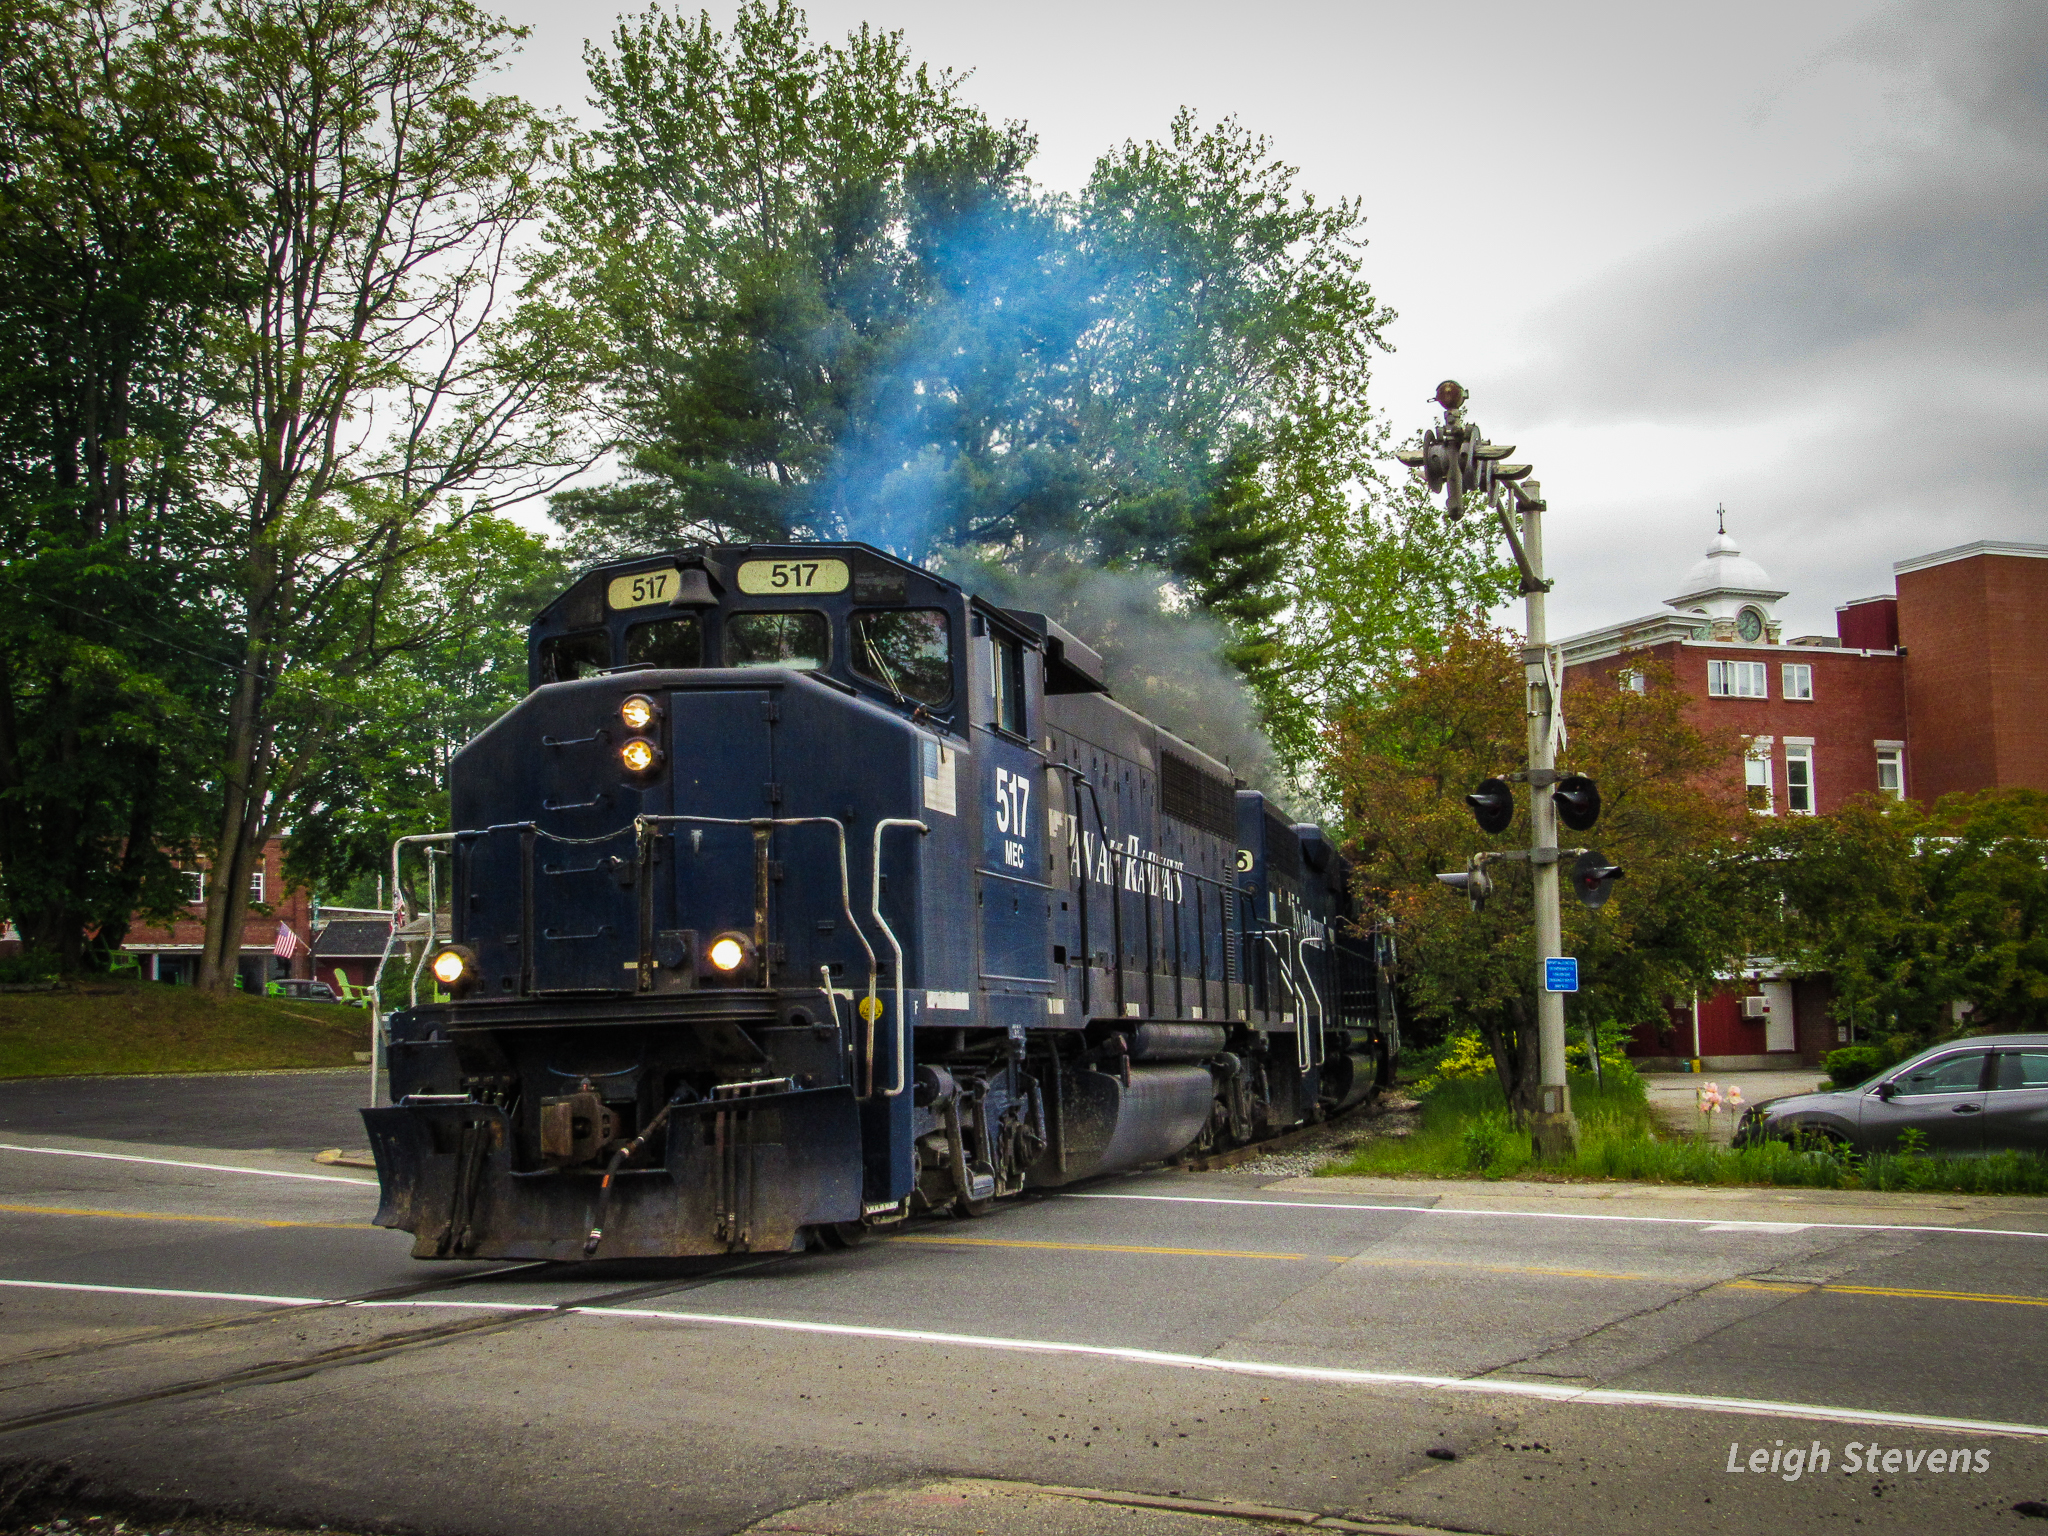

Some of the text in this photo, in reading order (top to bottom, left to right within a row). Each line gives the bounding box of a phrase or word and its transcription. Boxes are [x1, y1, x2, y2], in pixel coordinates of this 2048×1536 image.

[632, 575, 667, 601] 517
[771, 564, 818, 587] 517
[996, 767, 1030, 838] 517
[1005, 840, 1024, 869] MEC
